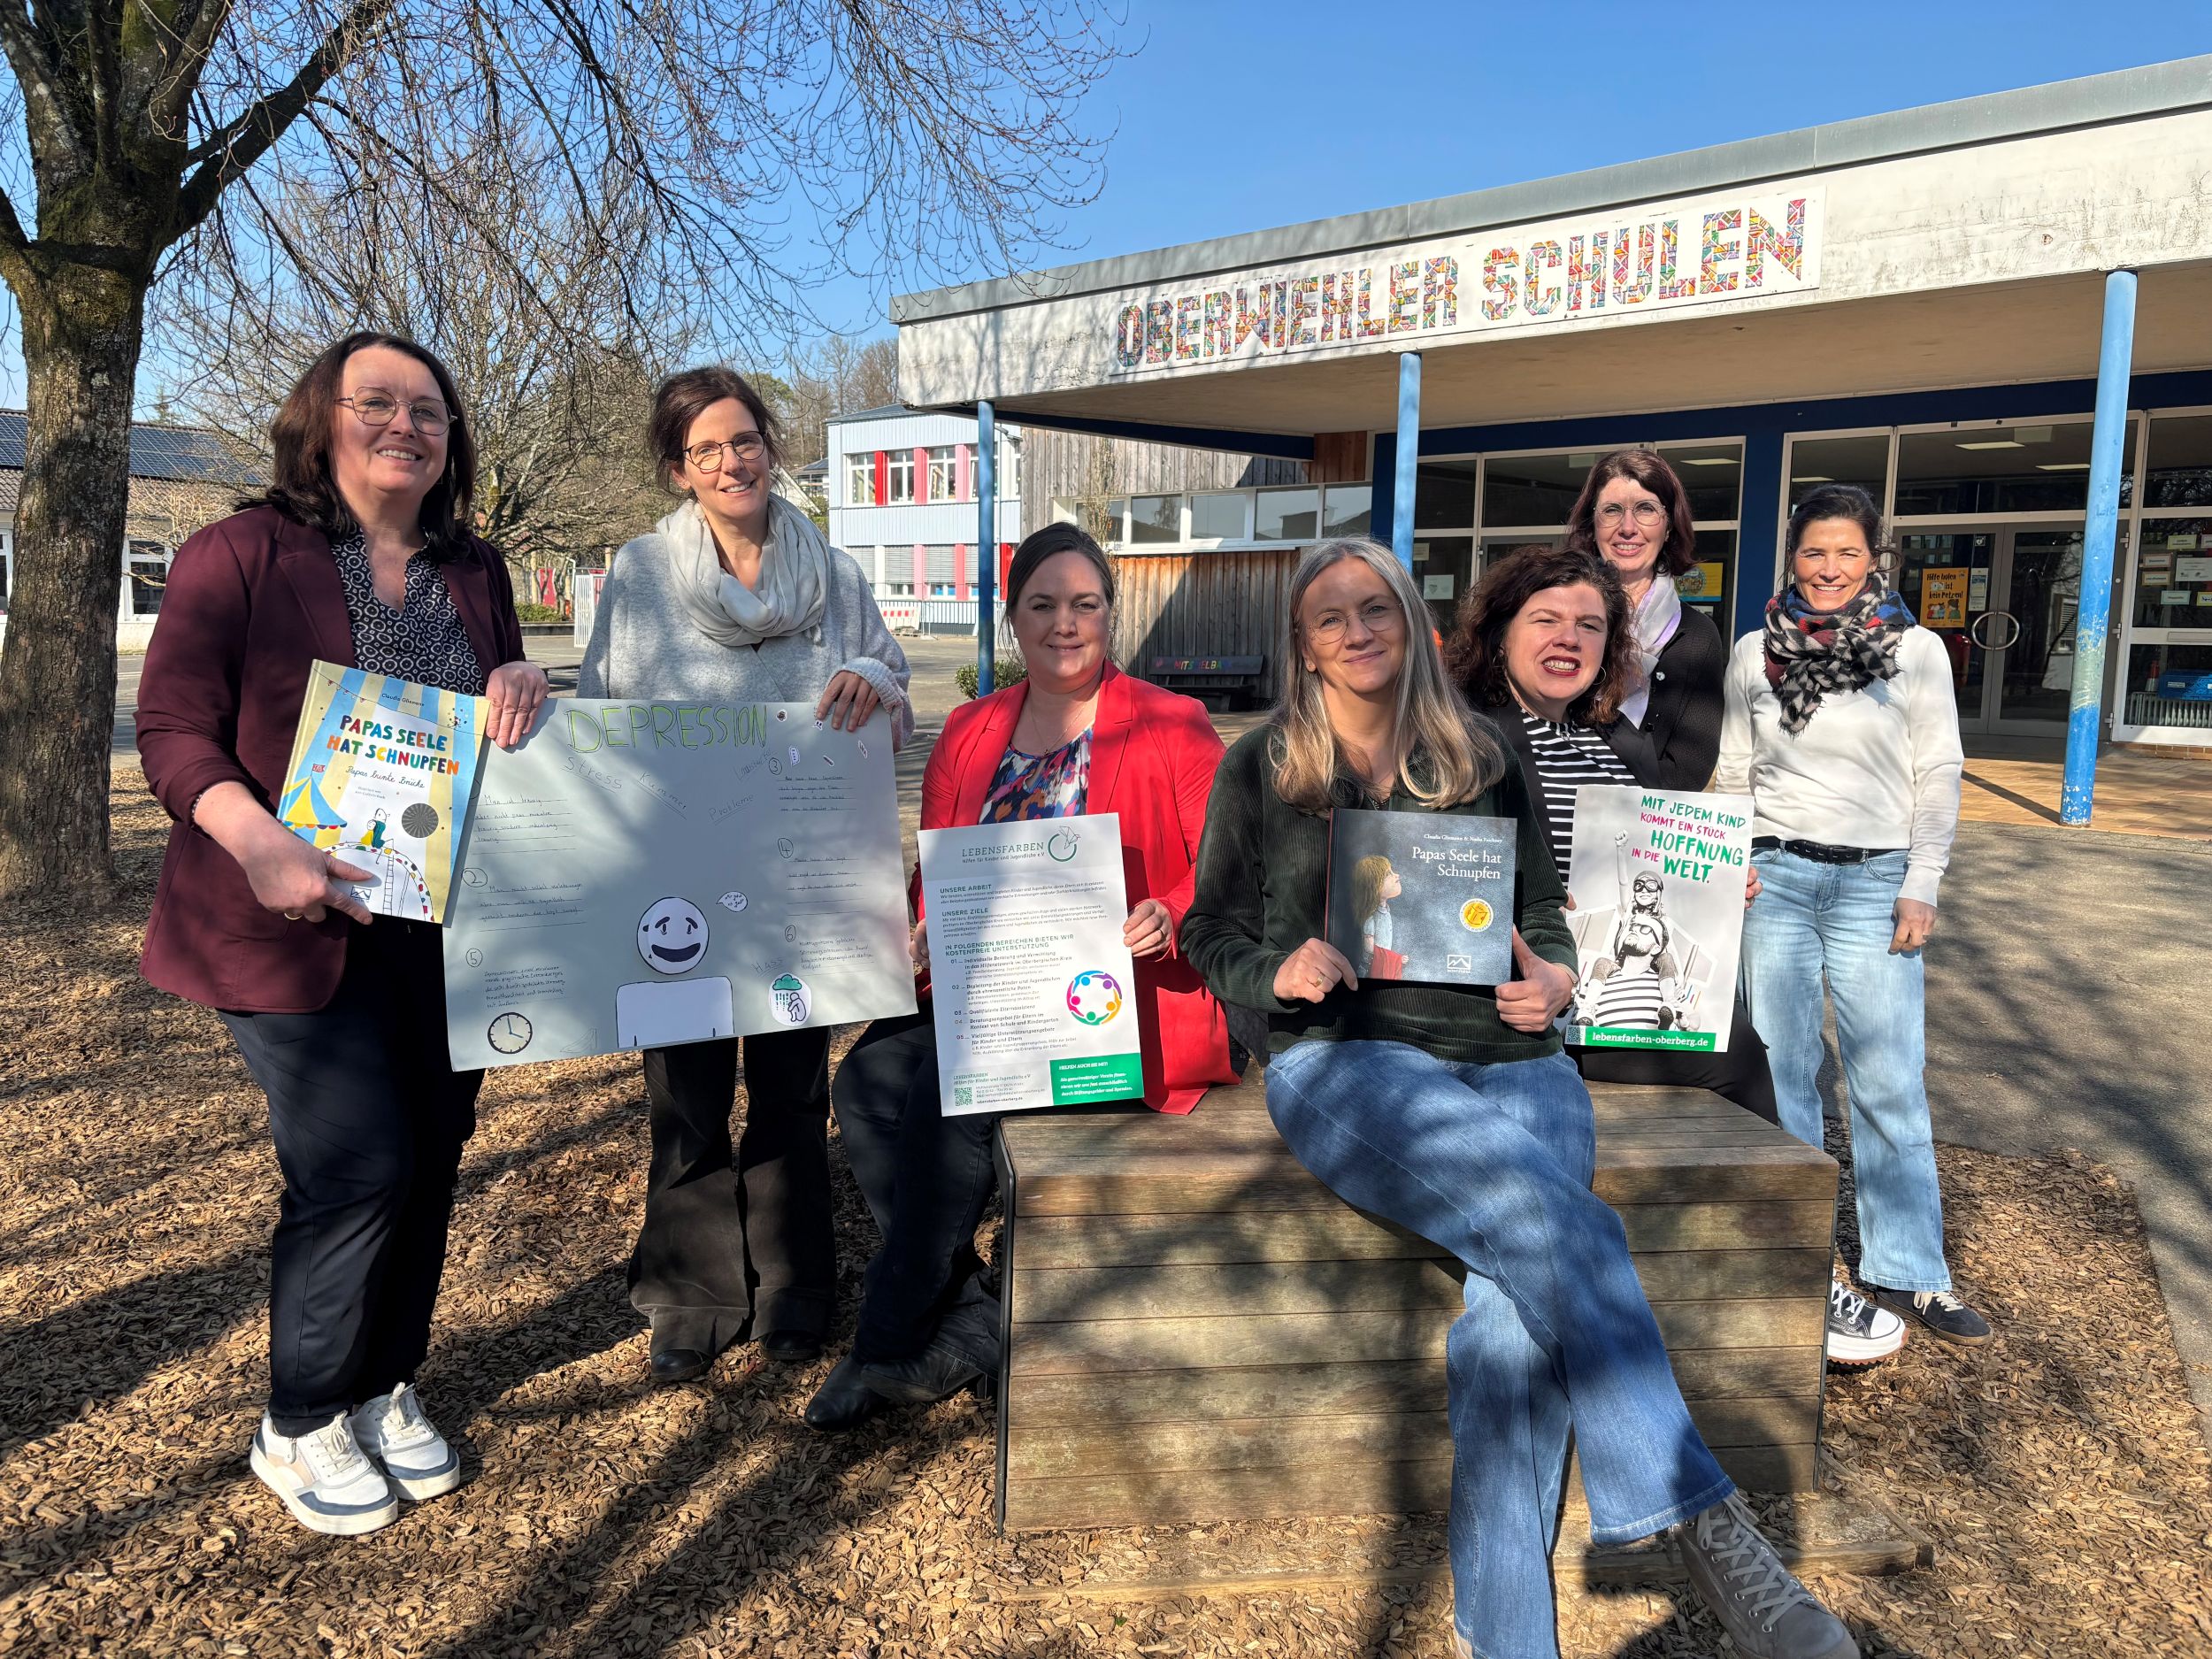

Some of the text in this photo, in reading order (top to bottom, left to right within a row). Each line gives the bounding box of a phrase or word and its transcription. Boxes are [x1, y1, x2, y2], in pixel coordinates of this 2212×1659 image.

[1118, 198, 1807, 369] OBERWIEHLER SCHULEN
[340, 715, 448, 751] PAPAS SEELE
[565, 704, 767, 753] DEPRESSION
[326, 735, 460, 775] HAT SCHNUPFEN
[346, 765, 425, 788] Papas bunte Brücke
[565, 757, 623, 789] Stress
[1640, 811, 1726, 840] KOMMT EIN STÜCK
[1641, 795, 1746, 829] MIT JEDEM KIND
[962, 842, 1044, 857] LEBENSFARBEN
[1412, 846, 1502, 864] Papas Seele hat
[1650, 830, 1743, 867] HOFFNUNG
[1438, 864, 1501, 882] Schnupfen
[1631, 848, 1713, 884] IN DIE WELT.
[945, 941, 1049, 956] KOSTENFREIE UNTERSTÜTZUNG
[954, 941, 995, 950] FOLGENDEN
[995, 937, 1033, 946] BEREICHEN
[1592, 1033, 1709, 1047] lebensfarben-oberberg.de
